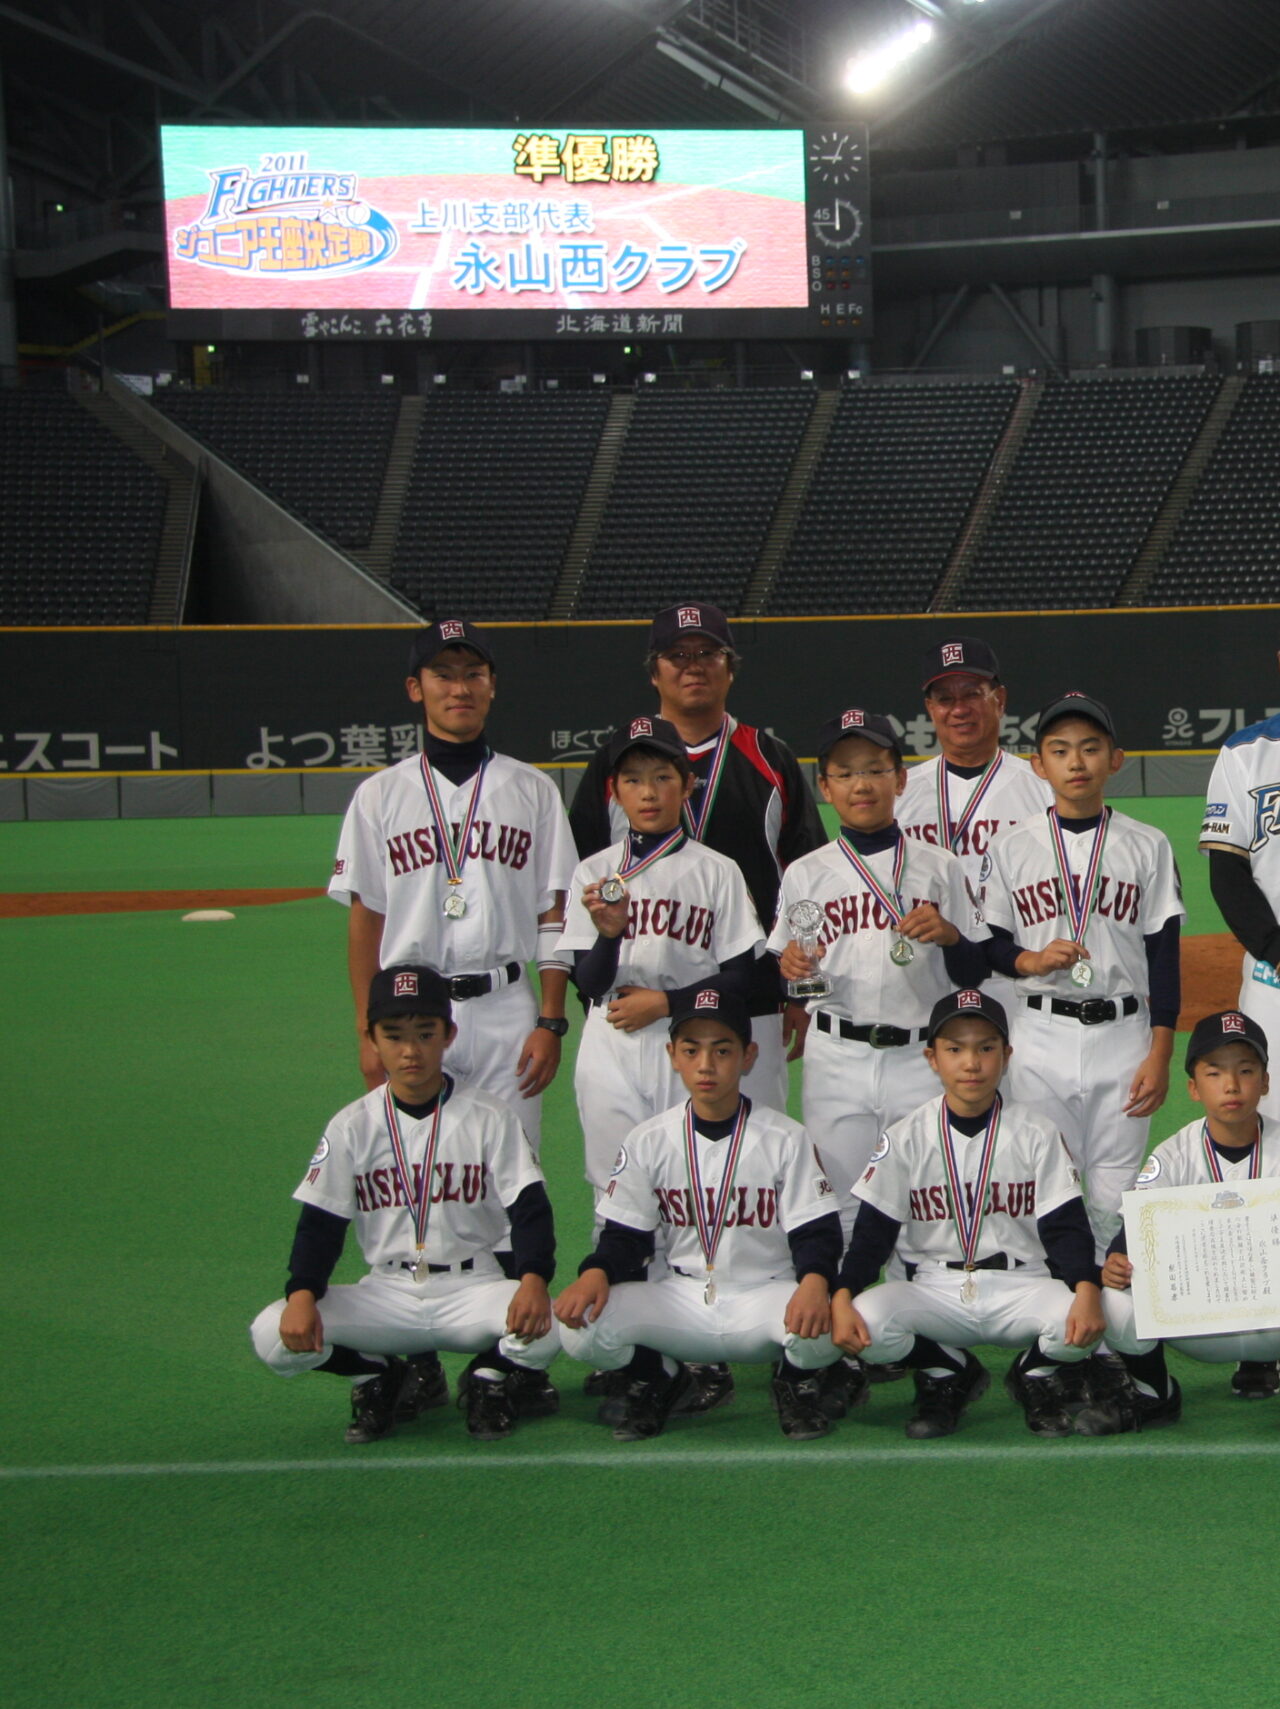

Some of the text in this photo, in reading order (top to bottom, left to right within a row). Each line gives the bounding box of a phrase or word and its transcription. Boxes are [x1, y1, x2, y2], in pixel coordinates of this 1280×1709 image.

[262, 154, 305, 172] 2011
[512, 134, 660, 183] 準優勝
[207, 171, 351, 218] FIGHTERS
[411, 202, 592, 230] 上川支部代表
[813, 208, 830, 220] 45
[454, 241, 745, 290] 永山西クラブ
[811, 255, 821, 266] B
[811, 268, 821, 279] S
[820, 304, 830, 314] H
[836, 304, 845, 314] E
[375, 311, 433, 338] 六花亭
[556, 314, 683, 334] 北海道新聞
[0, 731, 179, 770] スコート
